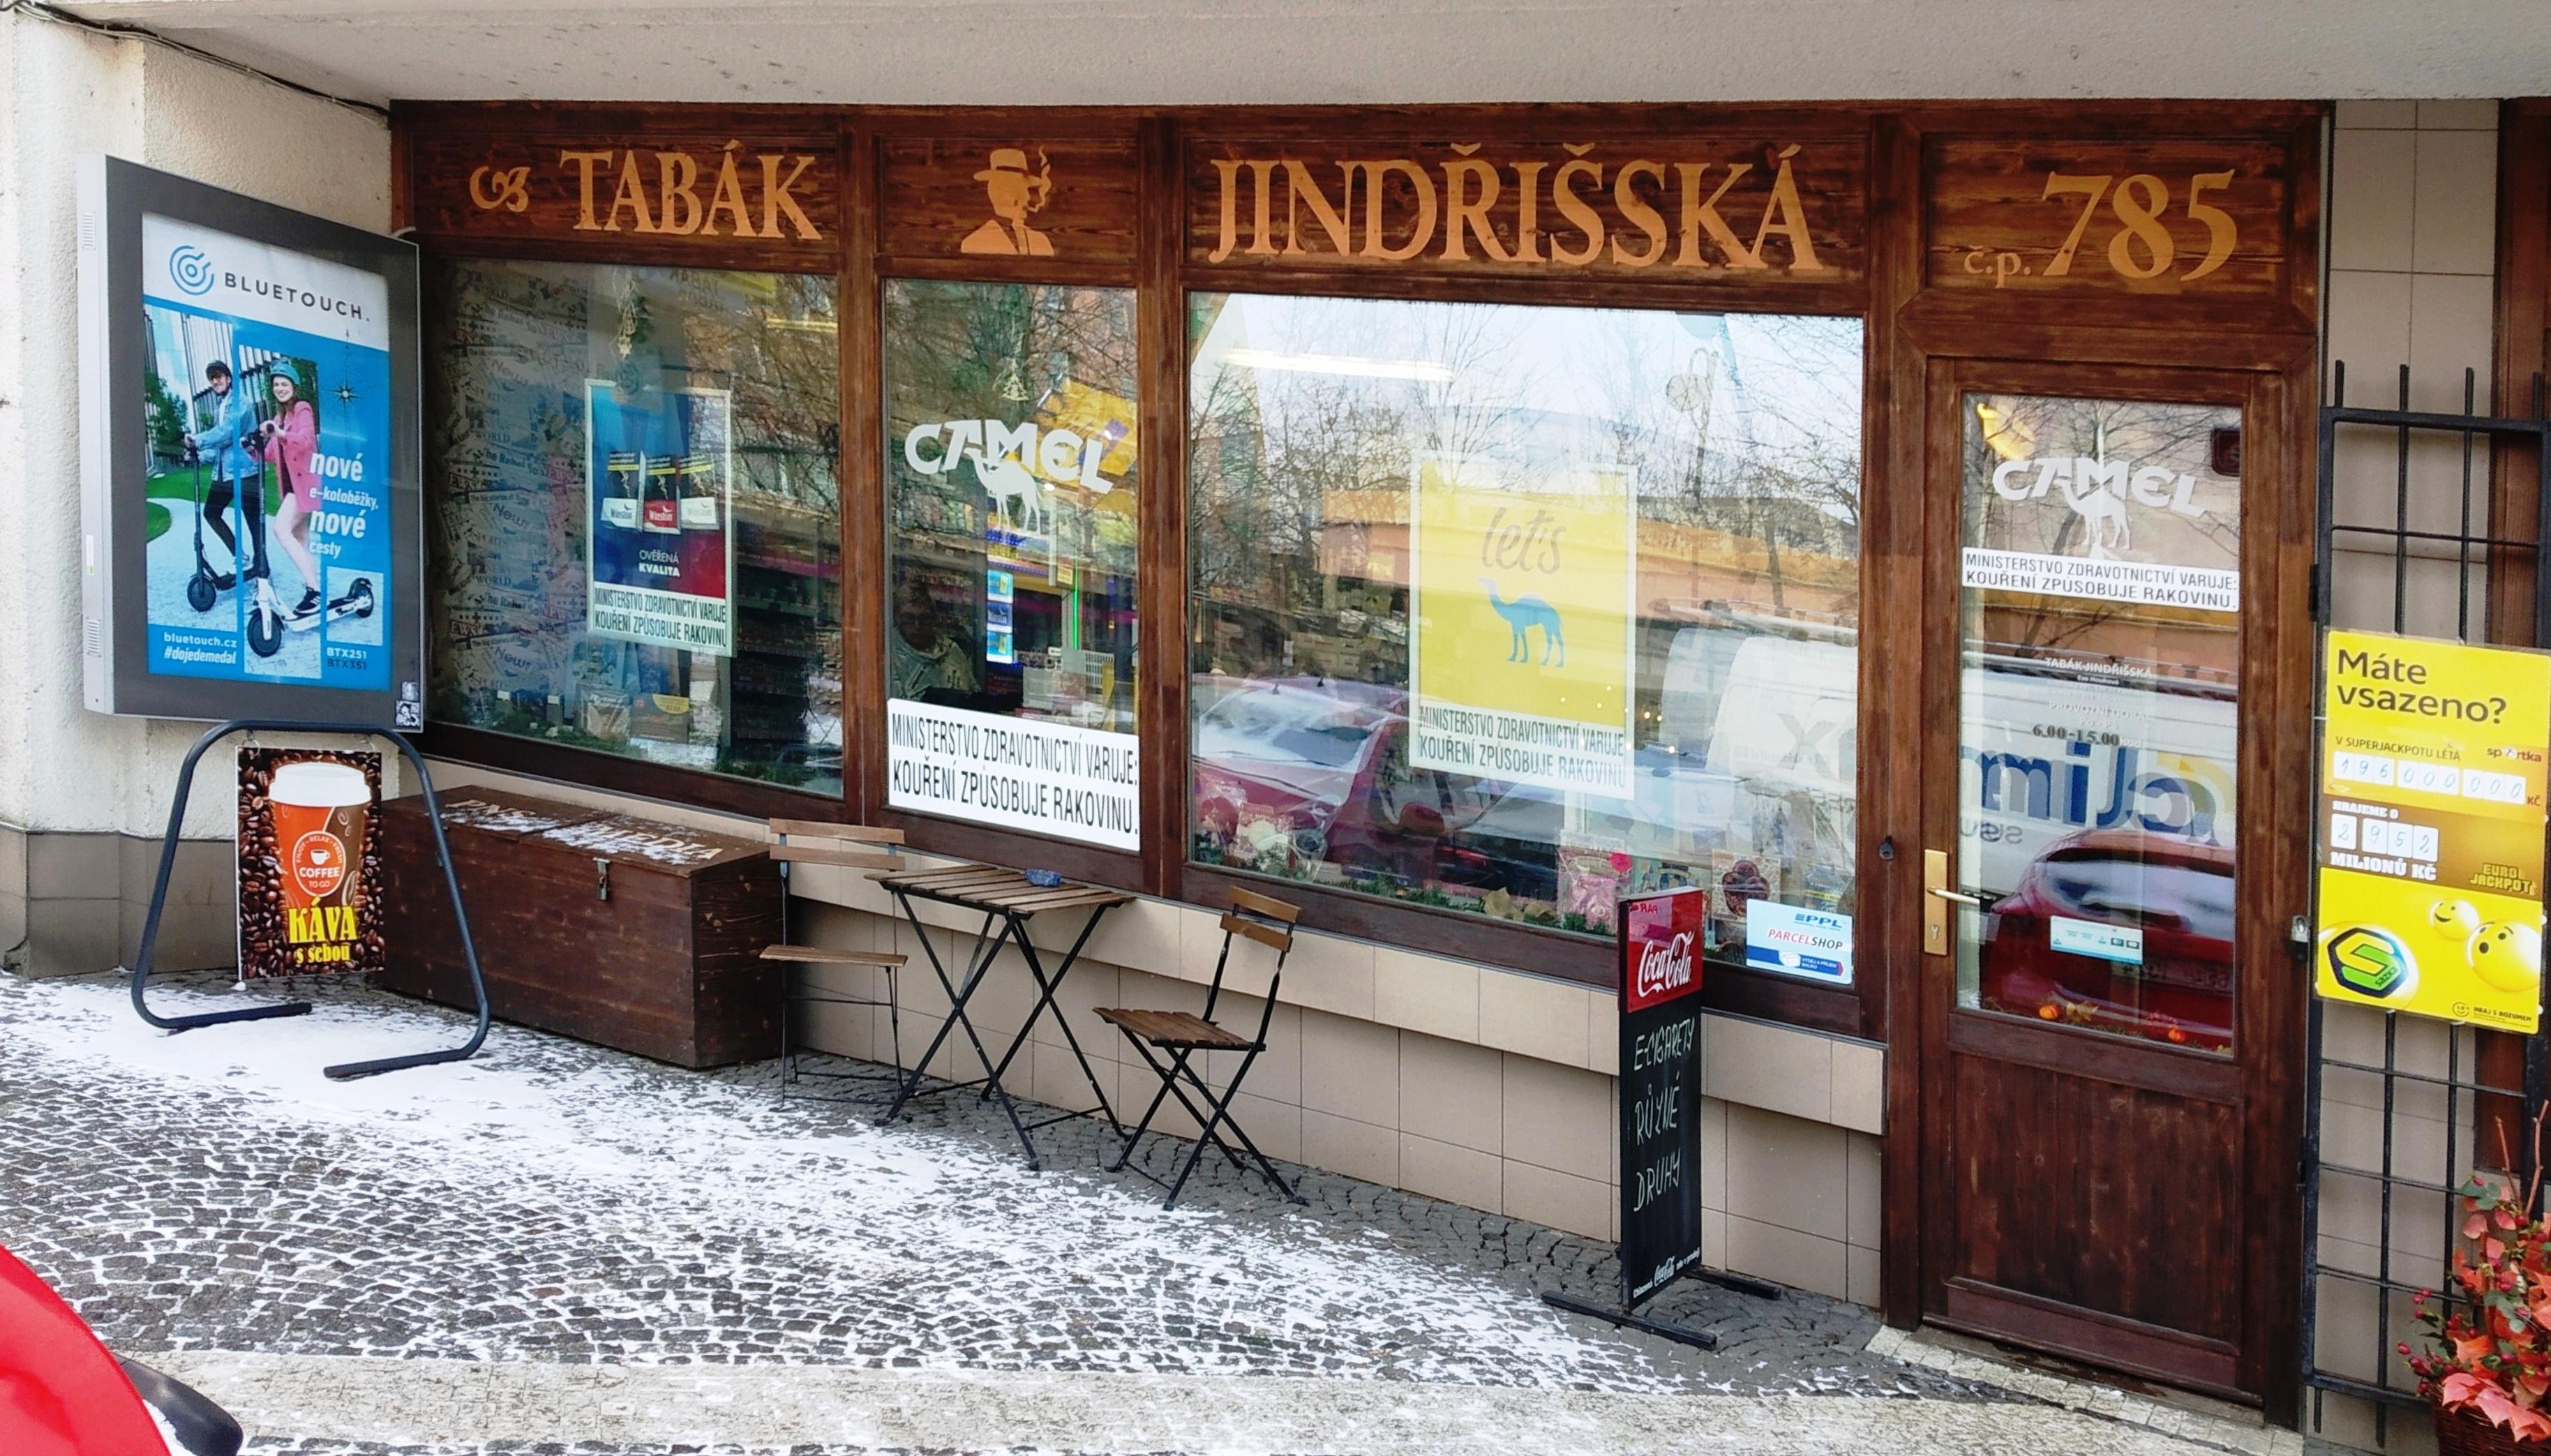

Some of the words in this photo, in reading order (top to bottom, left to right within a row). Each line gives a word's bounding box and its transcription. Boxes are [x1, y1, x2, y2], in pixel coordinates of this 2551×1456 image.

[560, 139, 821, 240] TABÁK
[1208, 142, 1824, 271] JINDŘIŠSKÁ
[1963, 245, 2031, 288] č.p.
[2042, 168, 2237, 282] 785
[310, 453, 363, 481] nové
[905, 419, 1114, 495] CAMEL
[1993, 457, 2209, 518] CAMEL
[309, 509, 367, 539] nové
[649, 510, 673, 522] Winston
[309, 542, 341, 559] cesty
[639, 550, 680, 564] OVĚŘENÁ
[638, 562, 680, 577] KVALITA
[1966, 553, 2063, 575] MINISTERSTVO
[2067, 562, 2176, 585] ZDRAVOTNICTVÍ
[2180, 573, 2238, 591] VARUJE:
[595, 588, 643, 611] MINISTERSTVO
[645, 594, 698, 620] ZDRAVOTNICTVÍ
[1967, 570, 2036, 589] KOUŘENÍ
[2042, 577, 2138, 599] ZPŮSOBUJE
[2144, 587, 2236, 609] RAKOVINU.
[164, 632, 237, 647] bluetouch.cz
[595, 610, 631, 633] KOUŘENÍ
[634, 614, 681, 640] ZPŮSOBUJE
[164, 646, 237, 665] #dojedemedal
[327, 647, 367, 659] BTX251
[327, 659, 367, 670] BTX351
[2337, 649, 2427, 684] Máte
[2337, 684, 2507, 724] vsazeno?
[1419, 705, 1493, 739] MINISTERSTVO
[1497, 717, 1580, 751] ZDRAVOTNICTVÍ
[2033, 723, 2120, 746] 6.00-15.00
[892, 713, 979, 759] MINISTERSTVO
[984, 728, 1082, 776] ZDRAVOTNICTVÍ
[1086, 744, 1138, 786] VARUJE:
[1420, 735, 1474, 763] KOUŘENÍ
[1479, 742, 1553, 776] ZPŮSOBUJE
[2335, 736, 2343, 746] V
[2346, 737, 2433, 758] SUPERJACKPOTU
[894, 755, 956, 800] KOUŘENÍ
[962, 765, 1048, 818] ZPŮSOBUJE
[1054, 786, 1138, 834] RAKOVINU.
[2333, 800, 2388, 818] HRAJEME
[299, 866, 341, 878] COFFEE
[2331, 851, 2407, 876] MILIONŮ
[2411, 862, 2437, 881] KČ
[2482, 862, 2521, 879] EURO
[2469, 873, 2536, 896] JACKPOT
[288, 896, 357, 943] KÁVA
[296, 946, 304, 963] s
[308, 943, 350, 963] sebou
[1768, 929, 1843, 950] PARCELSHOP
[1638, 931, 1695, 998] Coca-Cola
[1634, 1017, 1695, 1071] E-CIGARETY
[1633, 1148, 1681, 1212] DRUHY
